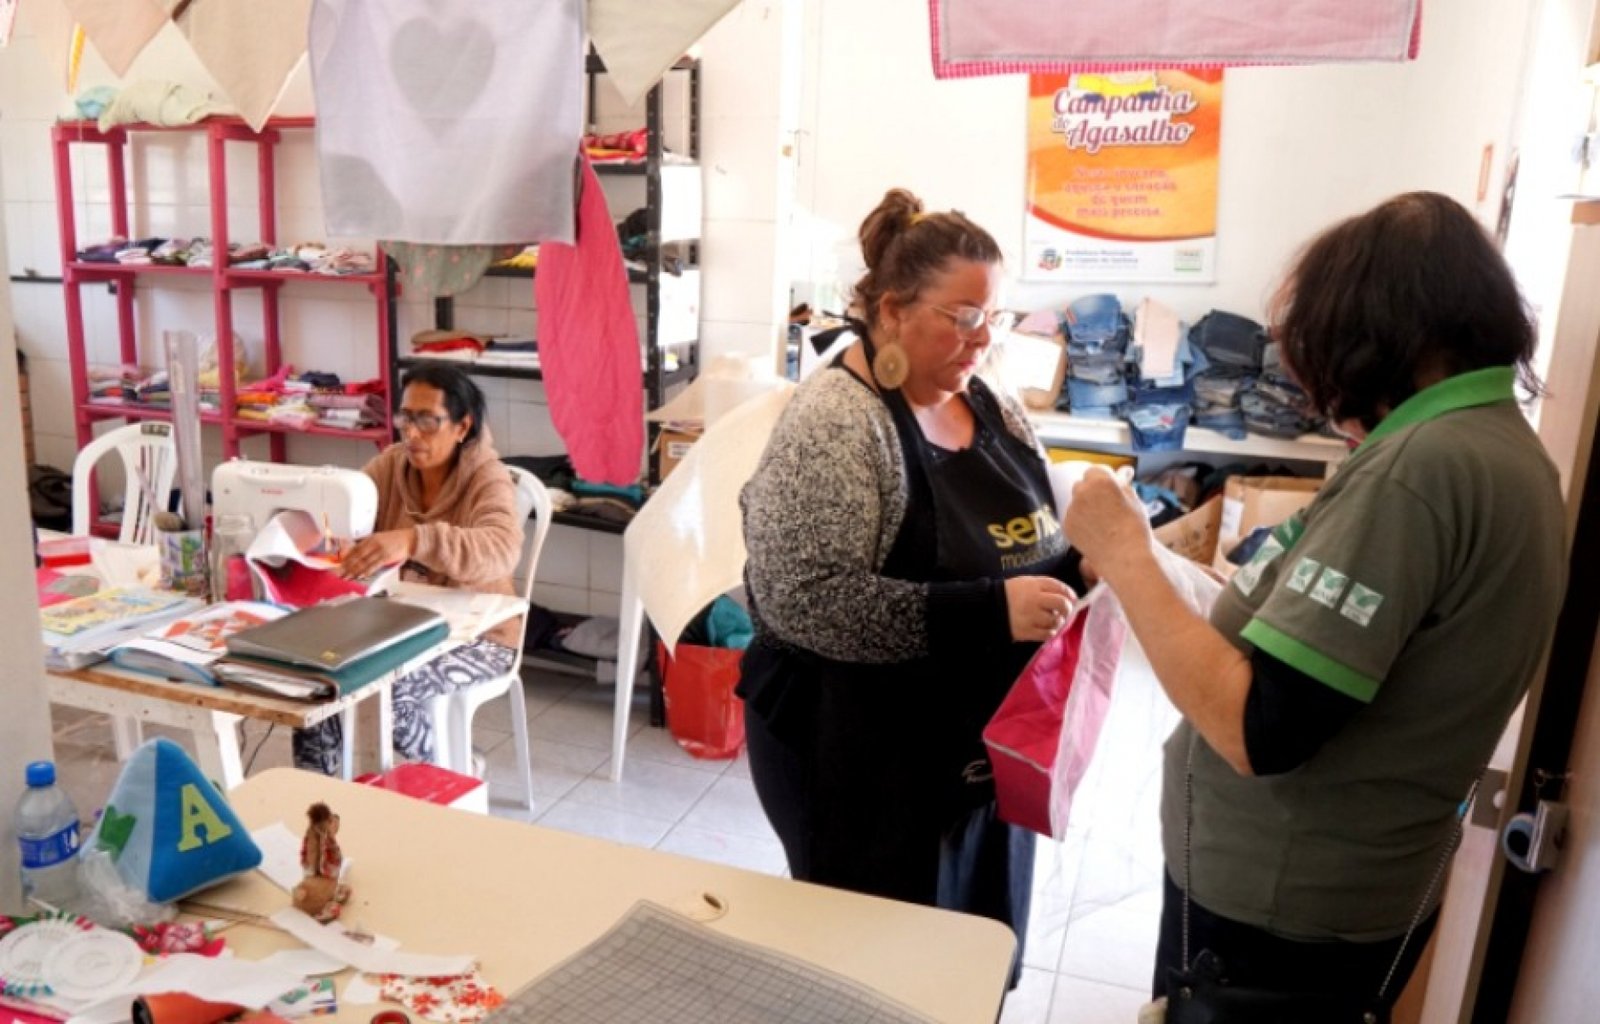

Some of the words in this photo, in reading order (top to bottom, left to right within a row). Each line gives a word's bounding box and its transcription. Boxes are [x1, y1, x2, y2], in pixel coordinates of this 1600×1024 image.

[1054, 87, 1193, 120] Campanha
[1069, 118, 1192, 149] Agasalho
[178, 783, 232, 852] A
